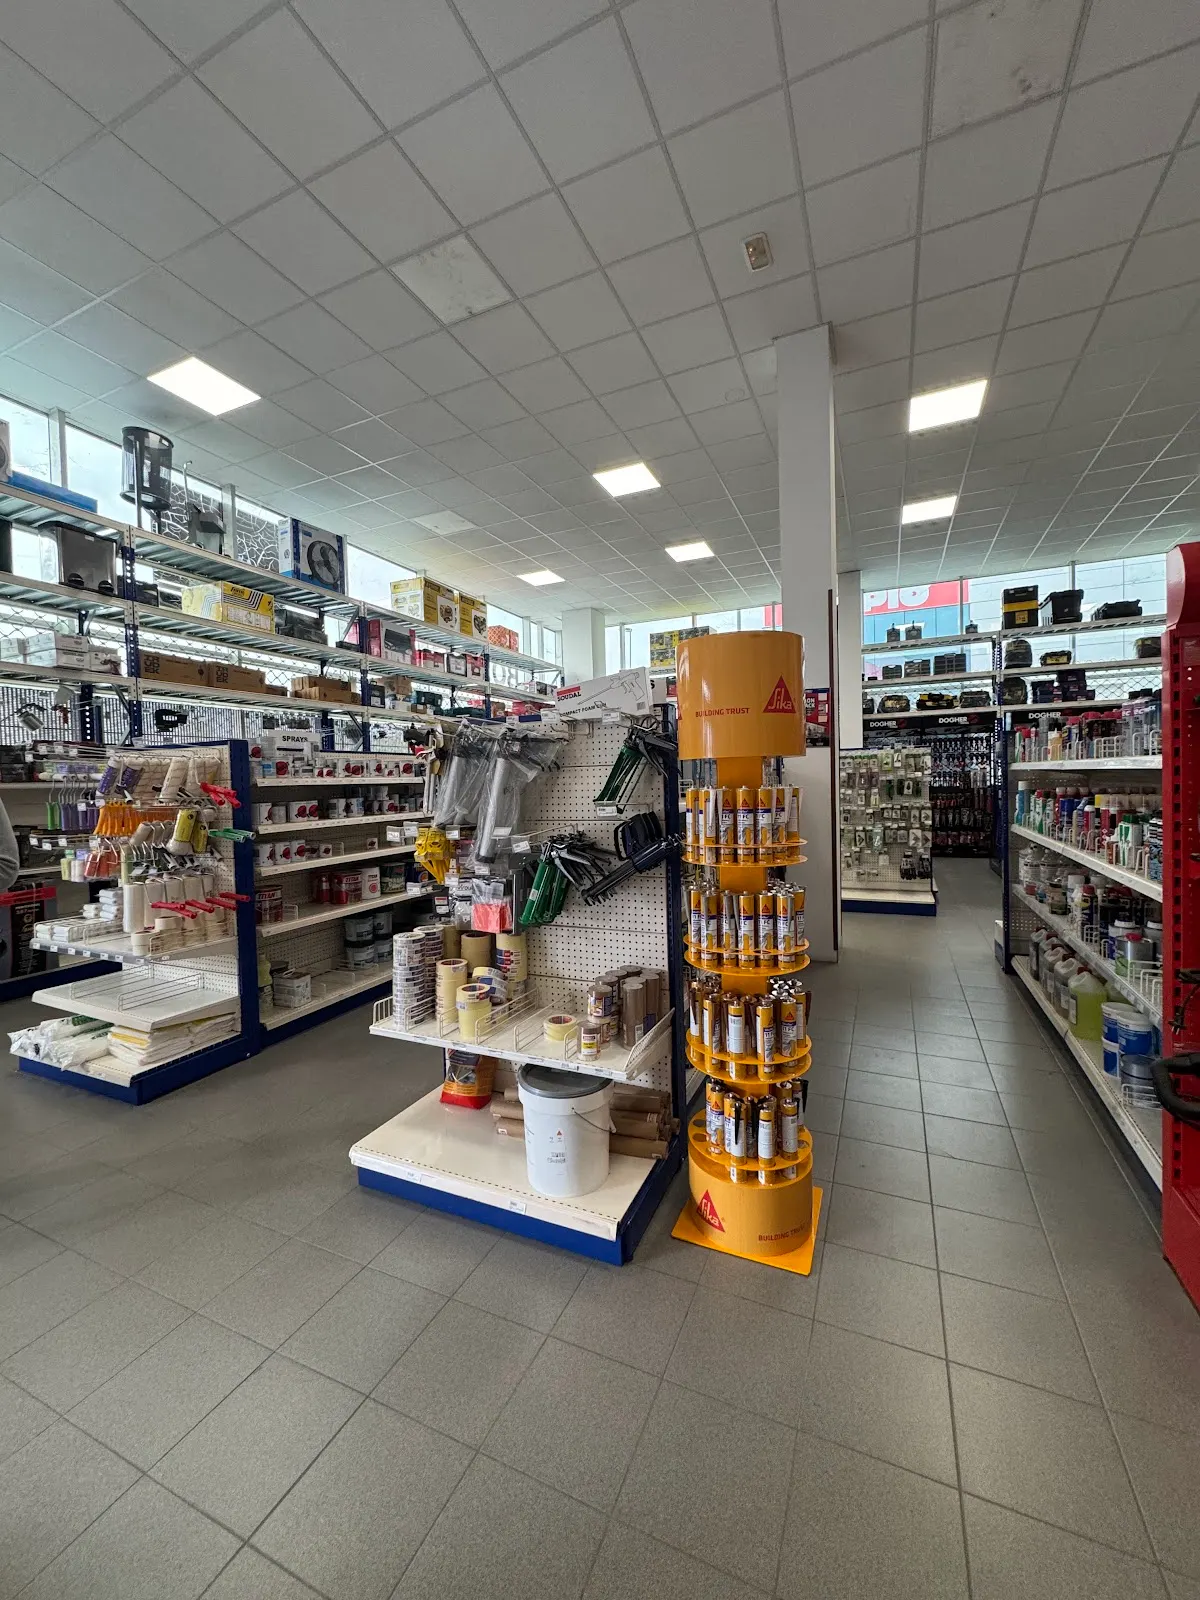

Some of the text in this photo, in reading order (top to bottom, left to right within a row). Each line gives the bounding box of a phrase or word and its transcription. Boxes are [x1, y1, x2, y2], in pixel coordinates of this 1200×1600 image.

[767, 688, 793, 710] Sika
[695, 707, 751, 718] BUILDING TRUST
[1028, 712, 1062, 720] DOGHER
[938, 716, 968, 724] DOGHER
[699, 1199, 720, 1227] Sika
